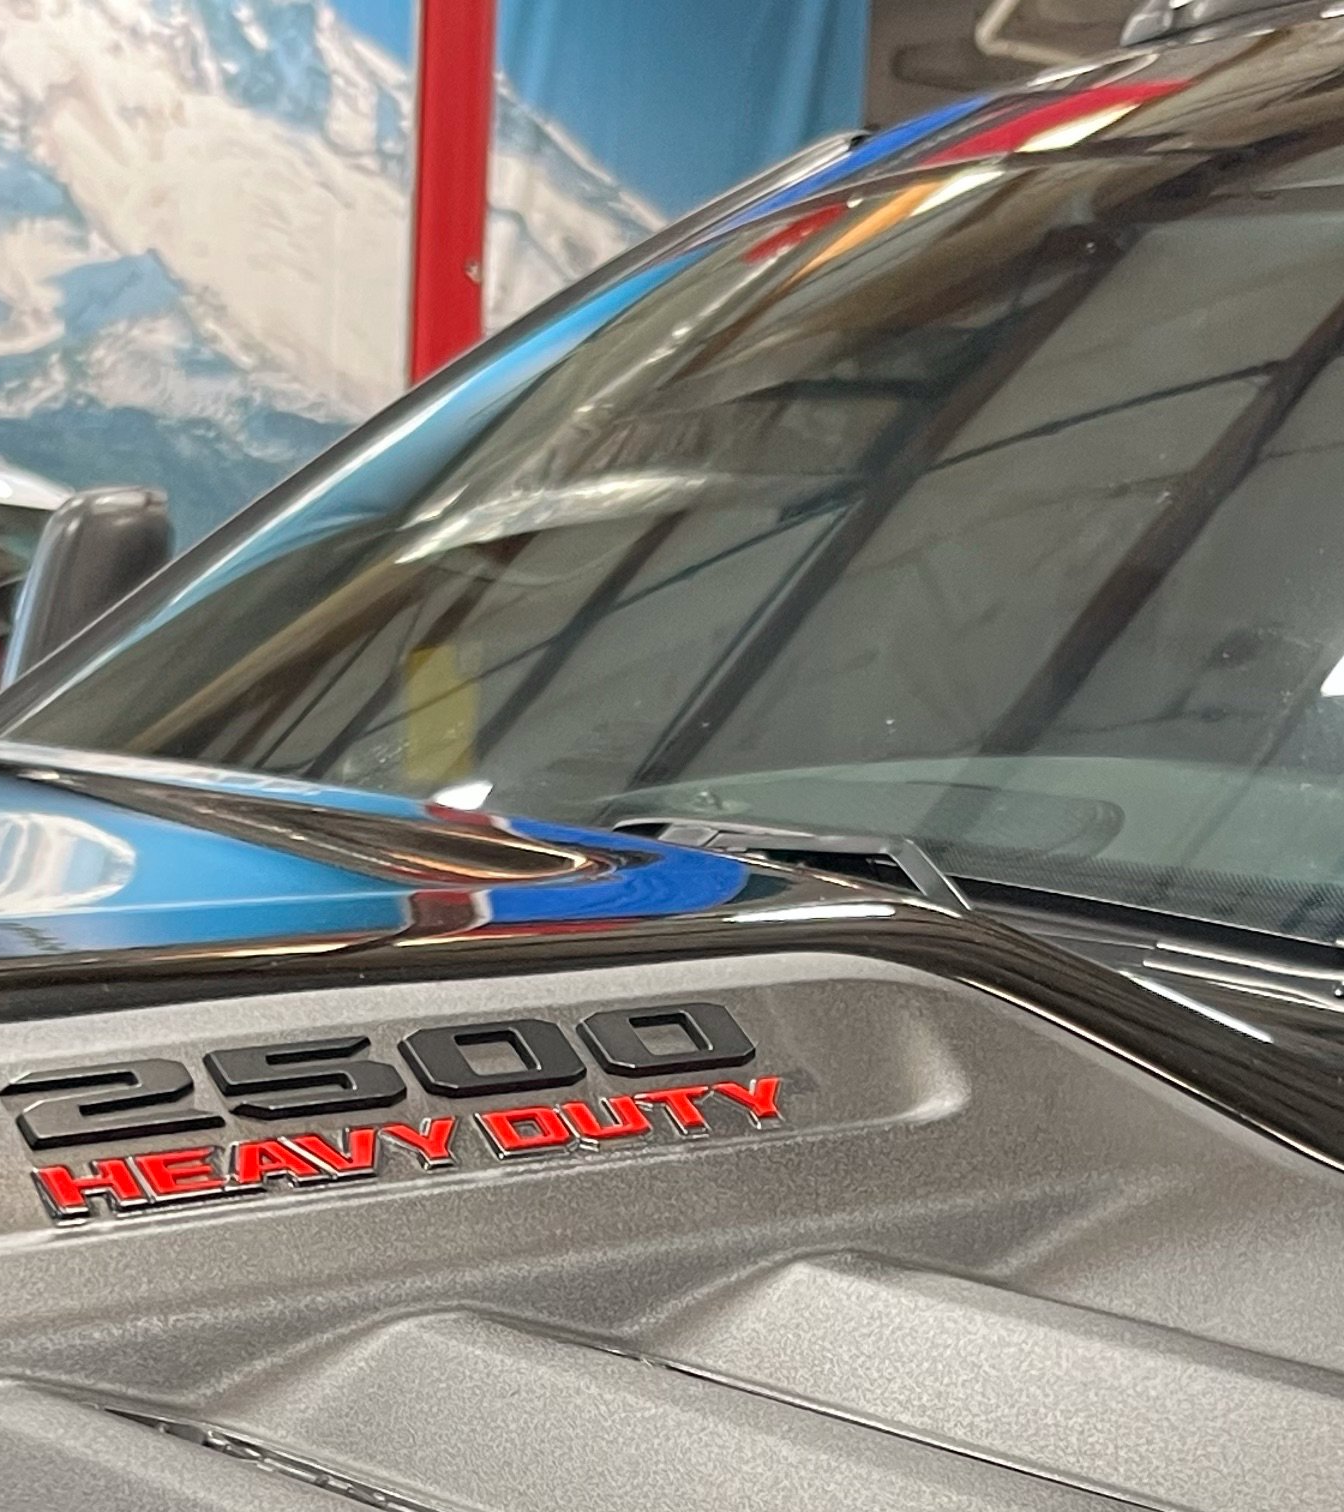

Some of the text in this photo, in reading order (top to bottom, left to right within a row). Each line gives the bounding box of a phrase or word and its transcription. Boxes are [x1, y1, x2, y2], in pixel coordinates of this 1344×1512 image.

[0, 1003, 758, 1150] 2500
[30, 1076, 784, 1225] HEAVY DUTY
